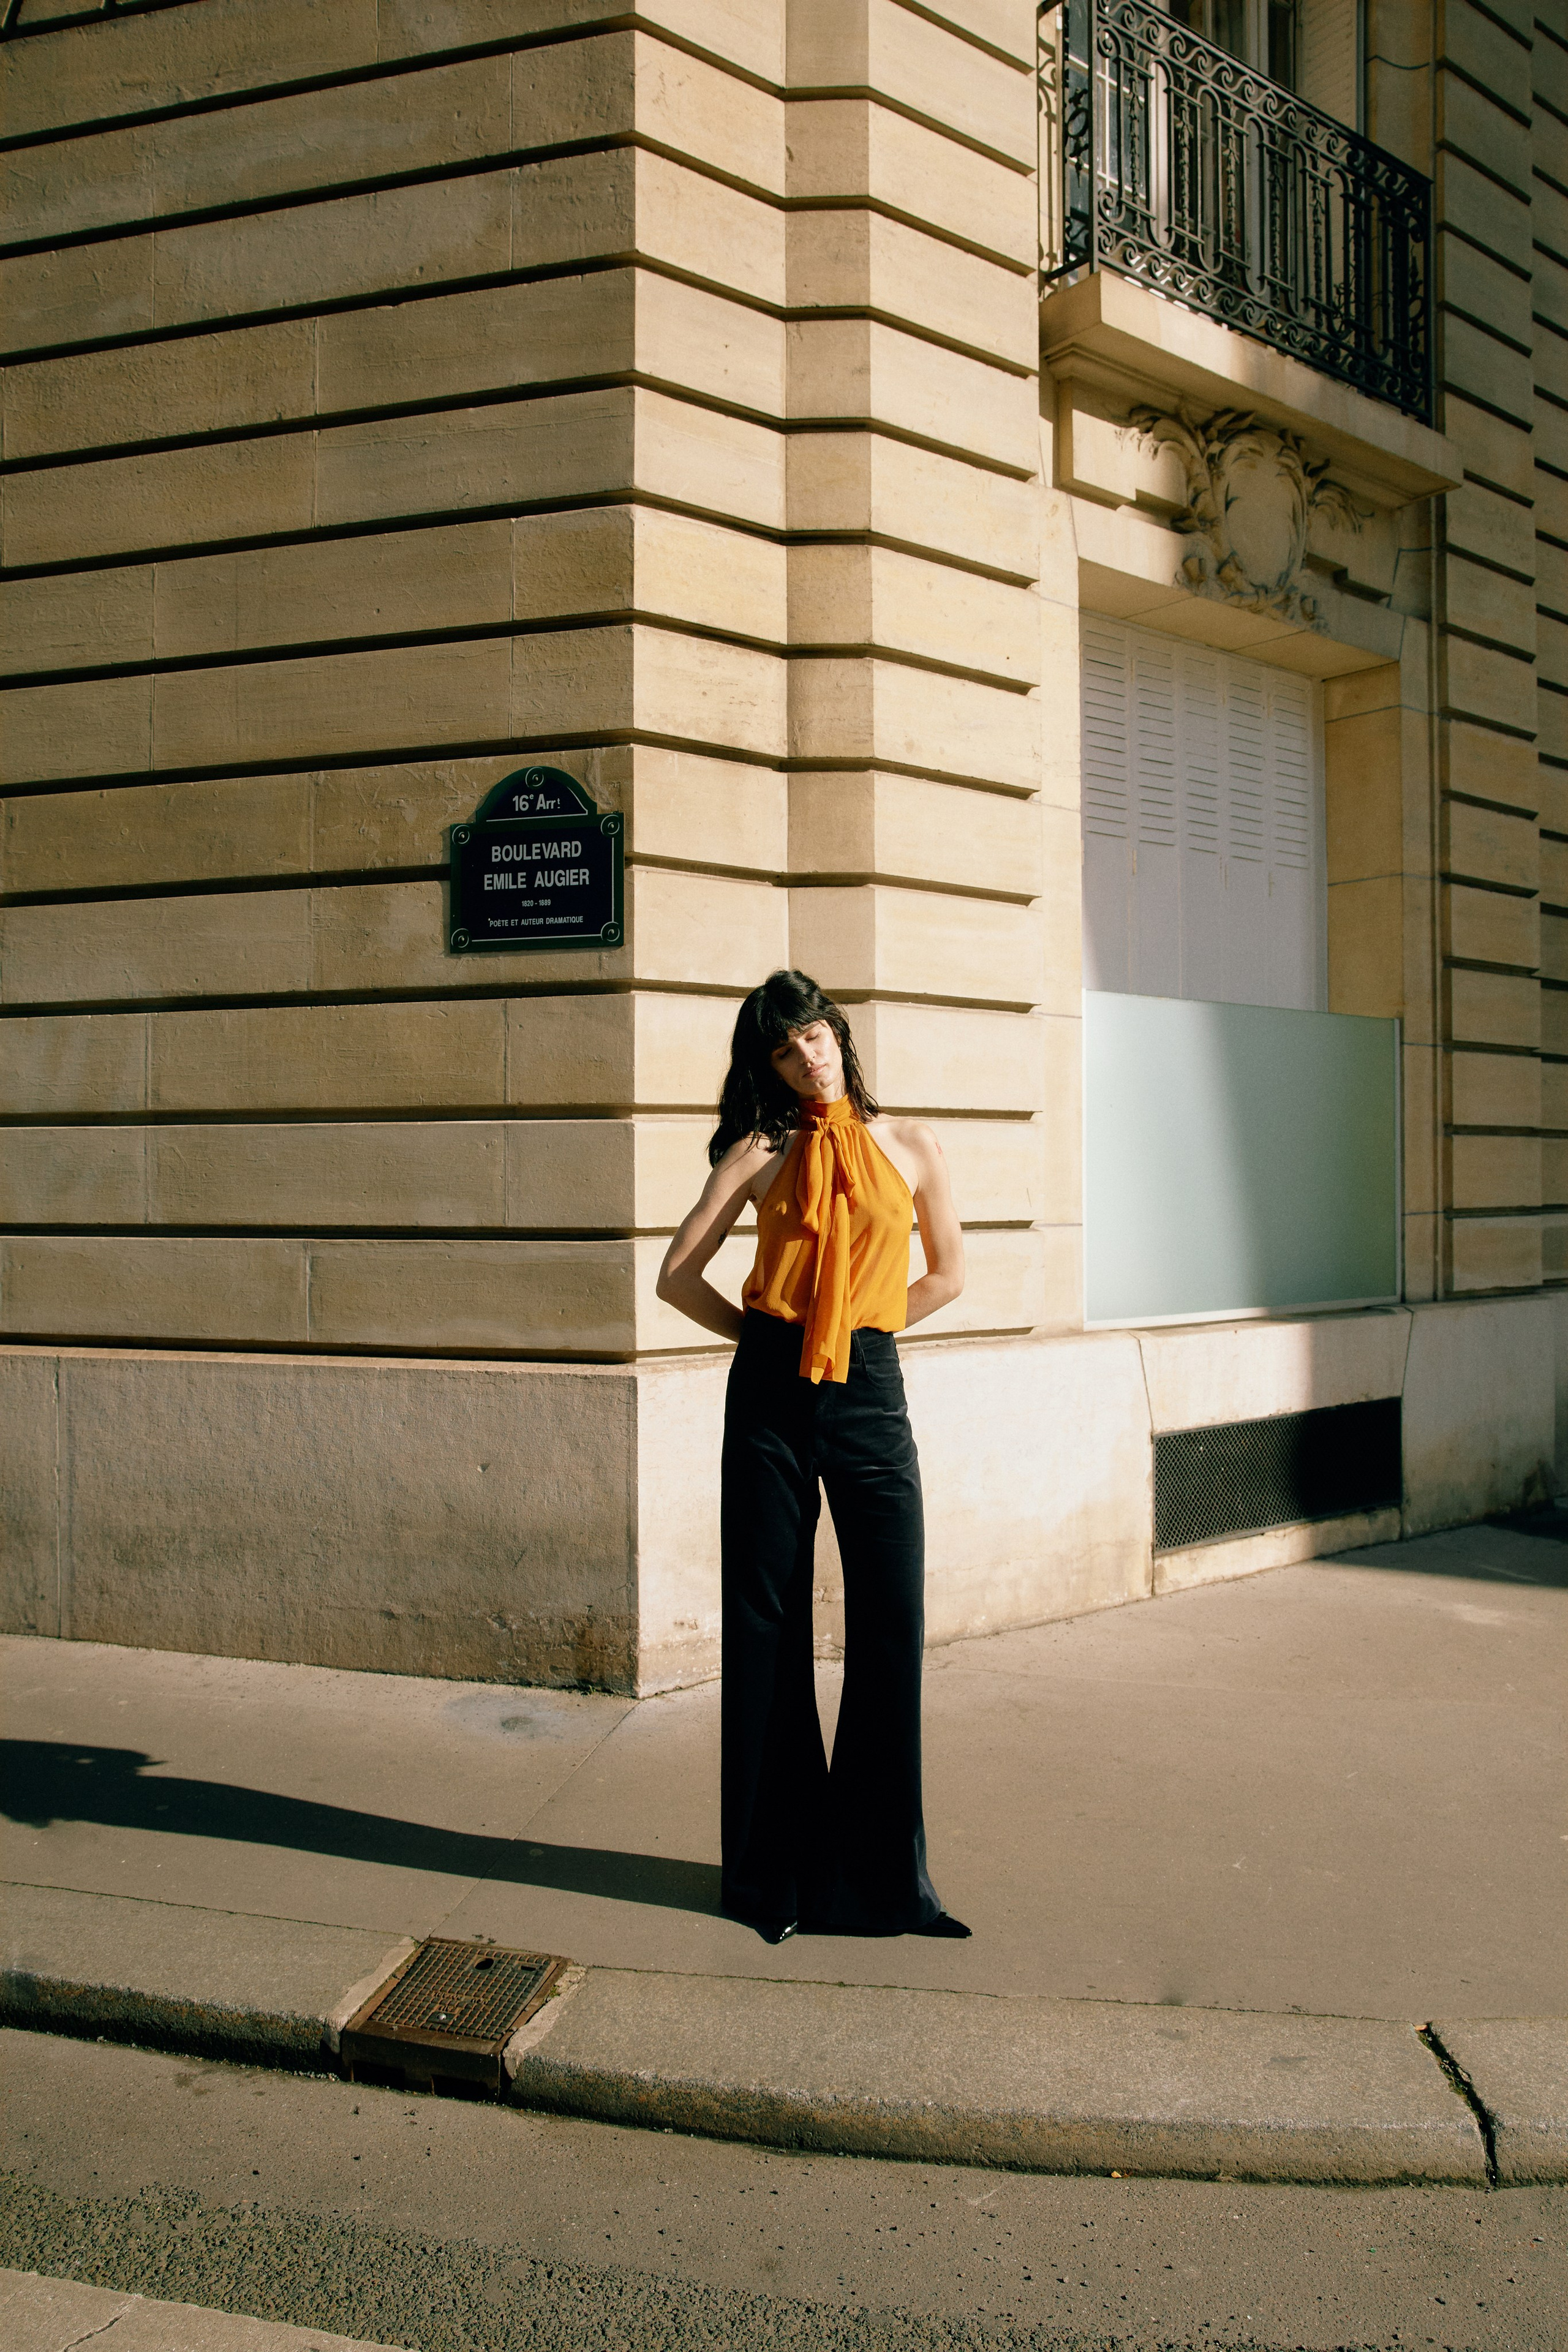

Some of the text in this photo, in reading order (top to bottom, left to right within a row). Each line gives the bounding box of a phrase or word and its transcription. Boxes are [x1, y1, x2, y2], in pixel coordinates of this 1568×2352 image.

[491, 840, 582, 862] BOULEVARD
[484, 869, 589, 890] EMILE AUGIER
[489, 919, 508, 927] POÈTE
[546, 916, 584, 924] DRAMATIQUE
